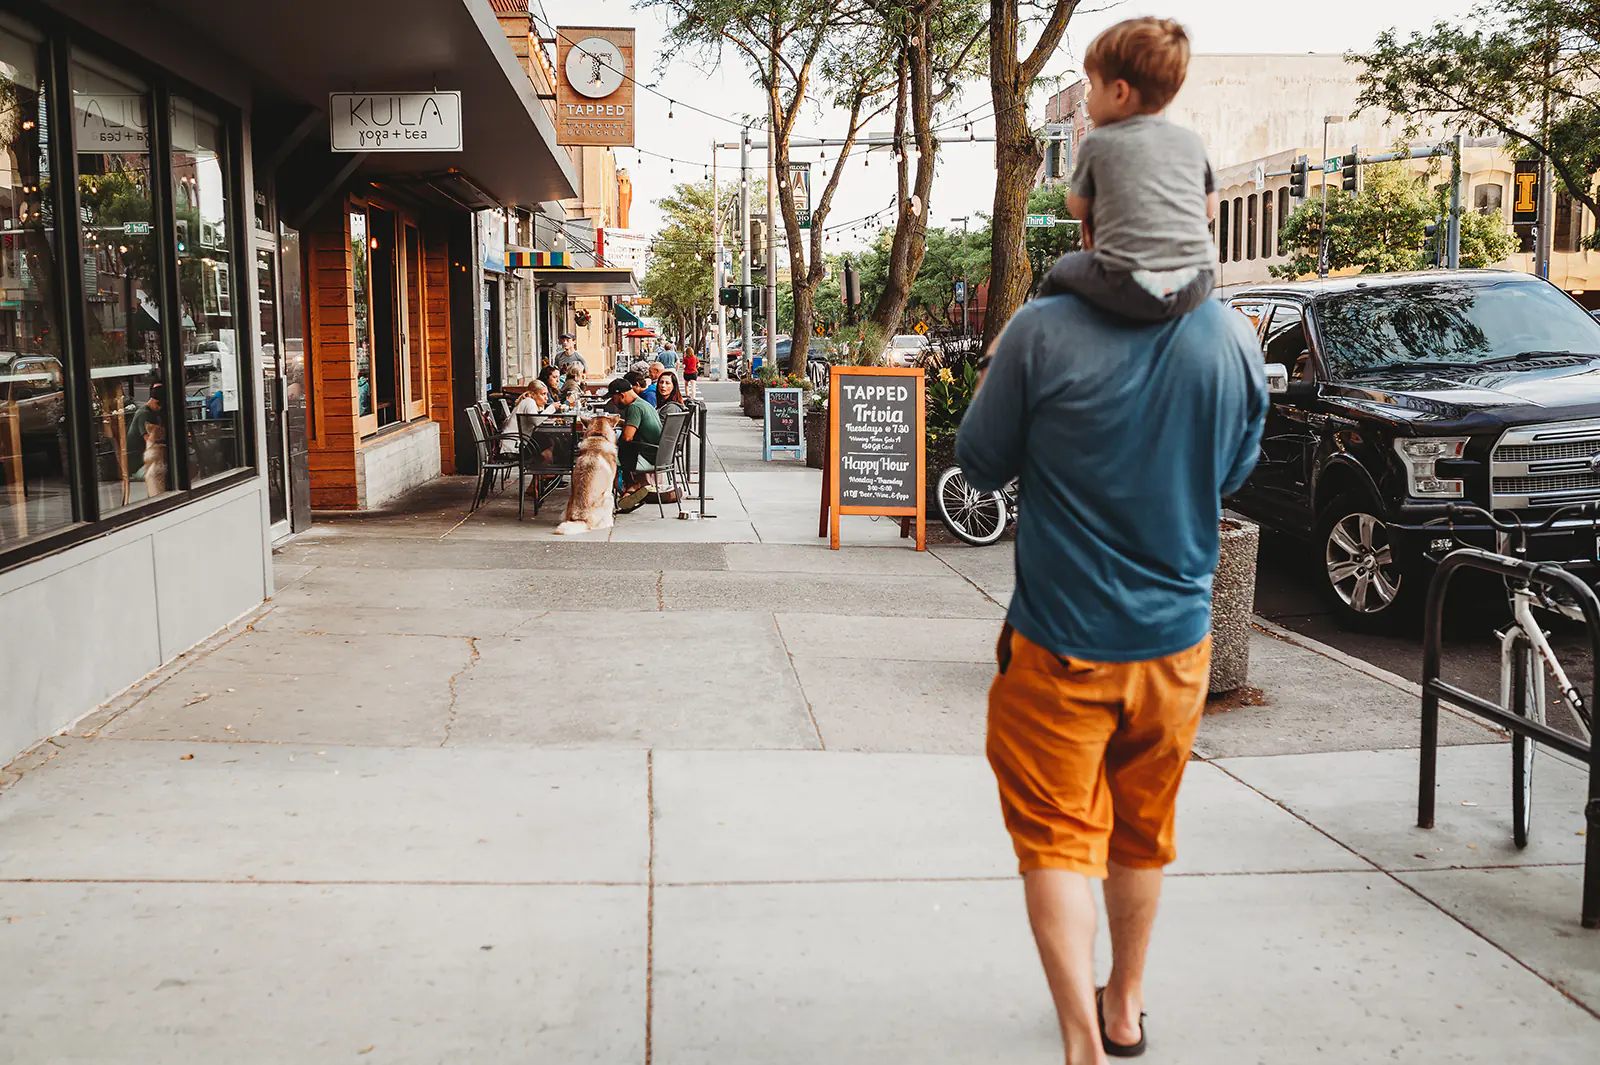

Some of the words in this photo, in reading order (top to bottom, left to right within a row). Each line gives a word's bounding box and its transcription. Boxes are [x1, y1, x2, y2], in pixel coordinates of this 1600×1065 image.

[350, 97, 443, 126] KULA
[566, 104, 626, 116] TAPPED
[359, 130, 389, 147] yoga
[404, 128, 428, 139] tea
[1515, 173, 1537, 213] I
[1027, 215, 1044, 225] Third
[1046, 216, 1055, 226] St
[843, 385, 908, 401] TAPPED
[852, 403, 903, 423] Trivia
[845, 423, 883, 435] Tuesdays
[892, 424, 909, 433] 7:30
[841, 456, 879, 475] Happy
[879, 457, 910, 472] Hour
